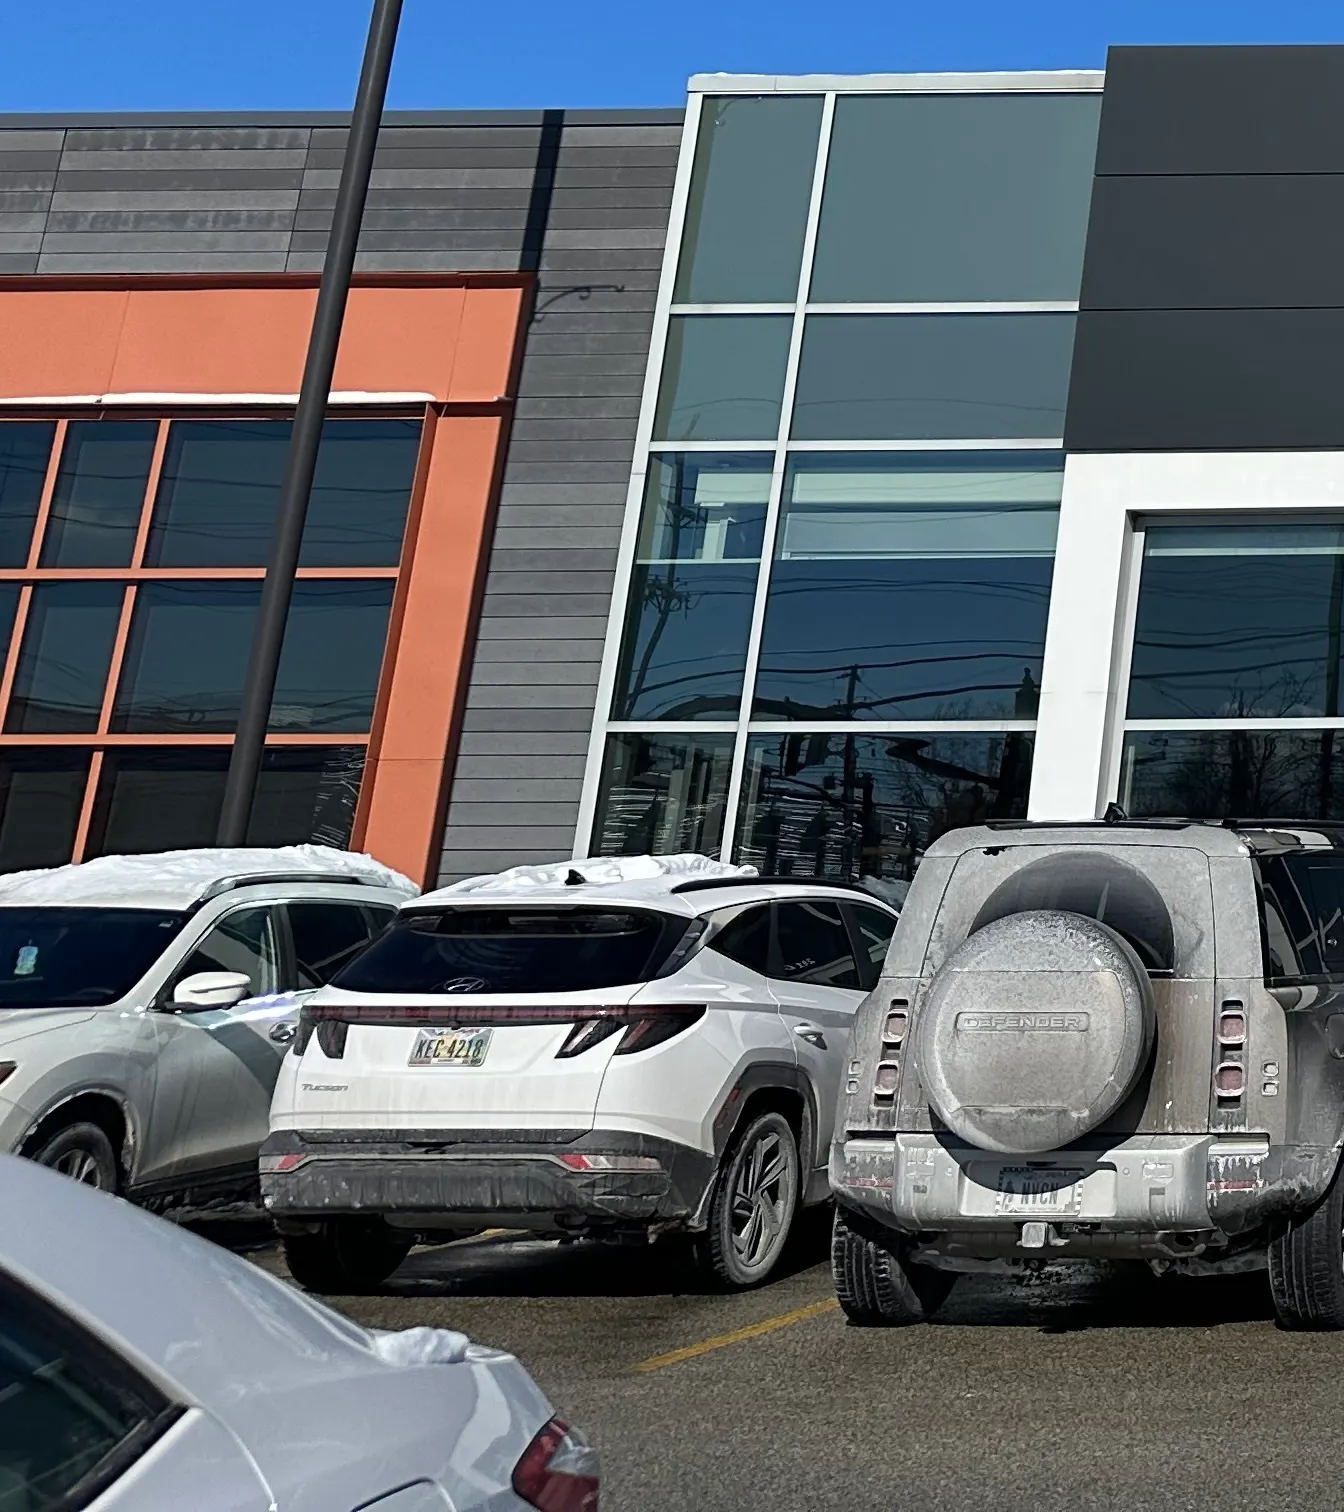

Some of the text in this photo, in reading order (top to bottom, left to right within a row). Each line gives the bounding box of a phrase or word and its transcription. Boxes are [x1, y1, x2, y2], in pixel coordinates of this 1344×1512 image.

[963, 1016, 1081, 1029] DEFENDER
[414, 1039, 484, 1058] KEC 4218
